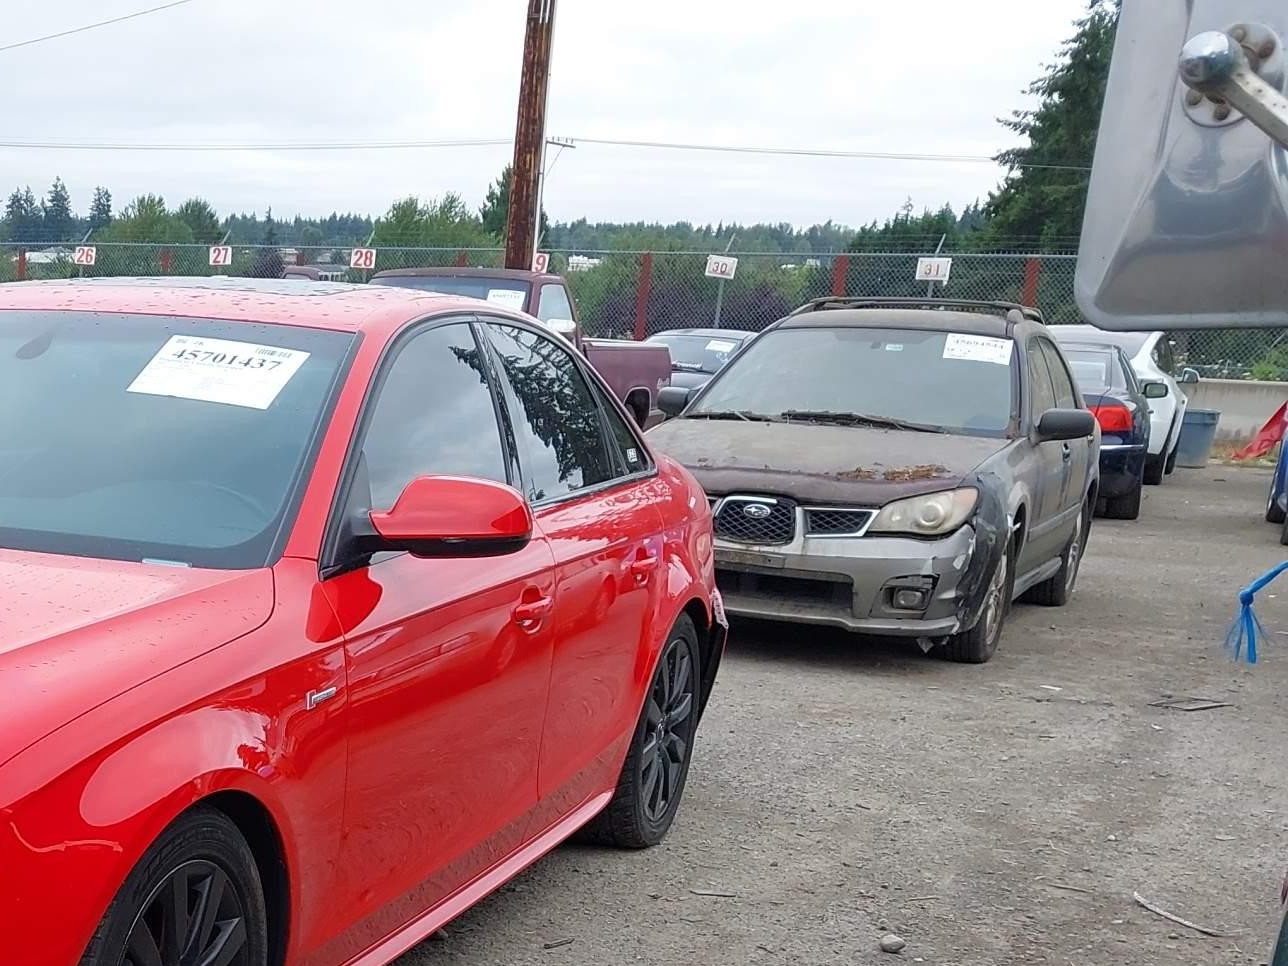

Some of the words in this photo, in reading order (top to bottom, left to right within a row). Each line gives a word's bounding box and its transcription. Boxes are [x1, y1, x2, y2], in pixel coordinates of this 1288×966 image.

[76, 247, 94, 263] 26
[212, 247, 229, 263] 27
[352, 250, 374, 267] 28
[534, 254, 547, 272] 9
[712, 261, 728, 274] 30
[924, 263, 940, 276] 31
[171, 348, 282, 372] 45701437
